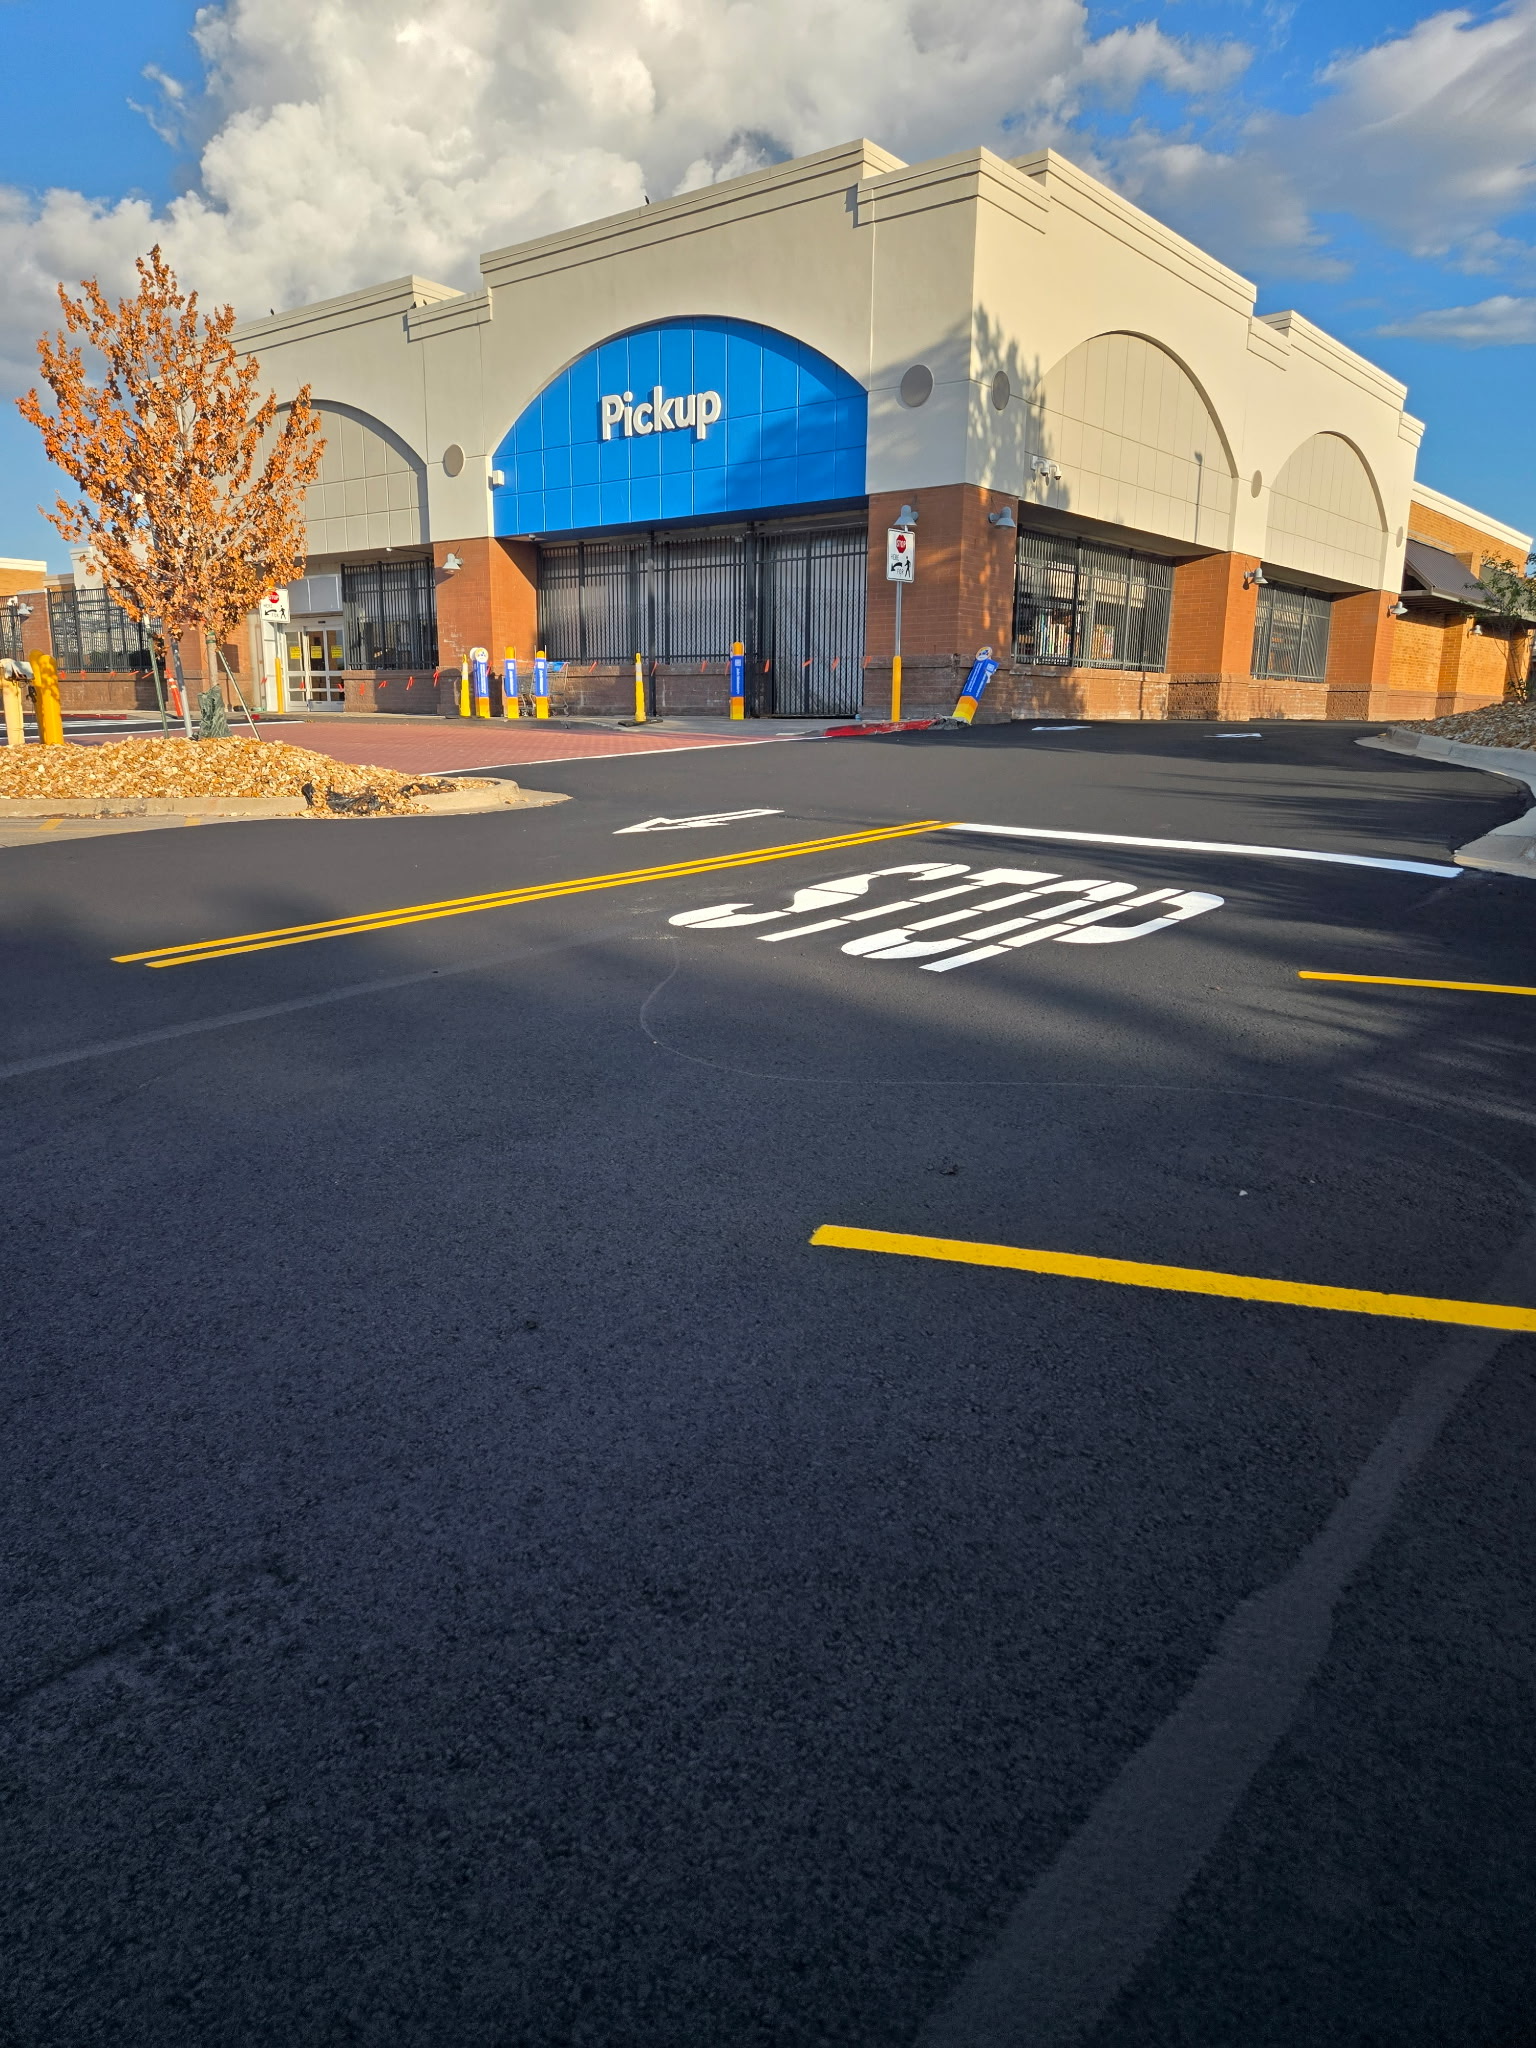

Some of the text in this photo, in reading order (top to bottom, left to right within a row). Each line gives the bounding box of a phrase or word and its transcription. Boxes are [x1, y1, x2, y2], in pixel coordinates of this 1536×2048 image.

[601, 385, 722, 441] Pickup
[896, 540, 906, 549] STOP
[667, 861, 1225, 973] STOP
